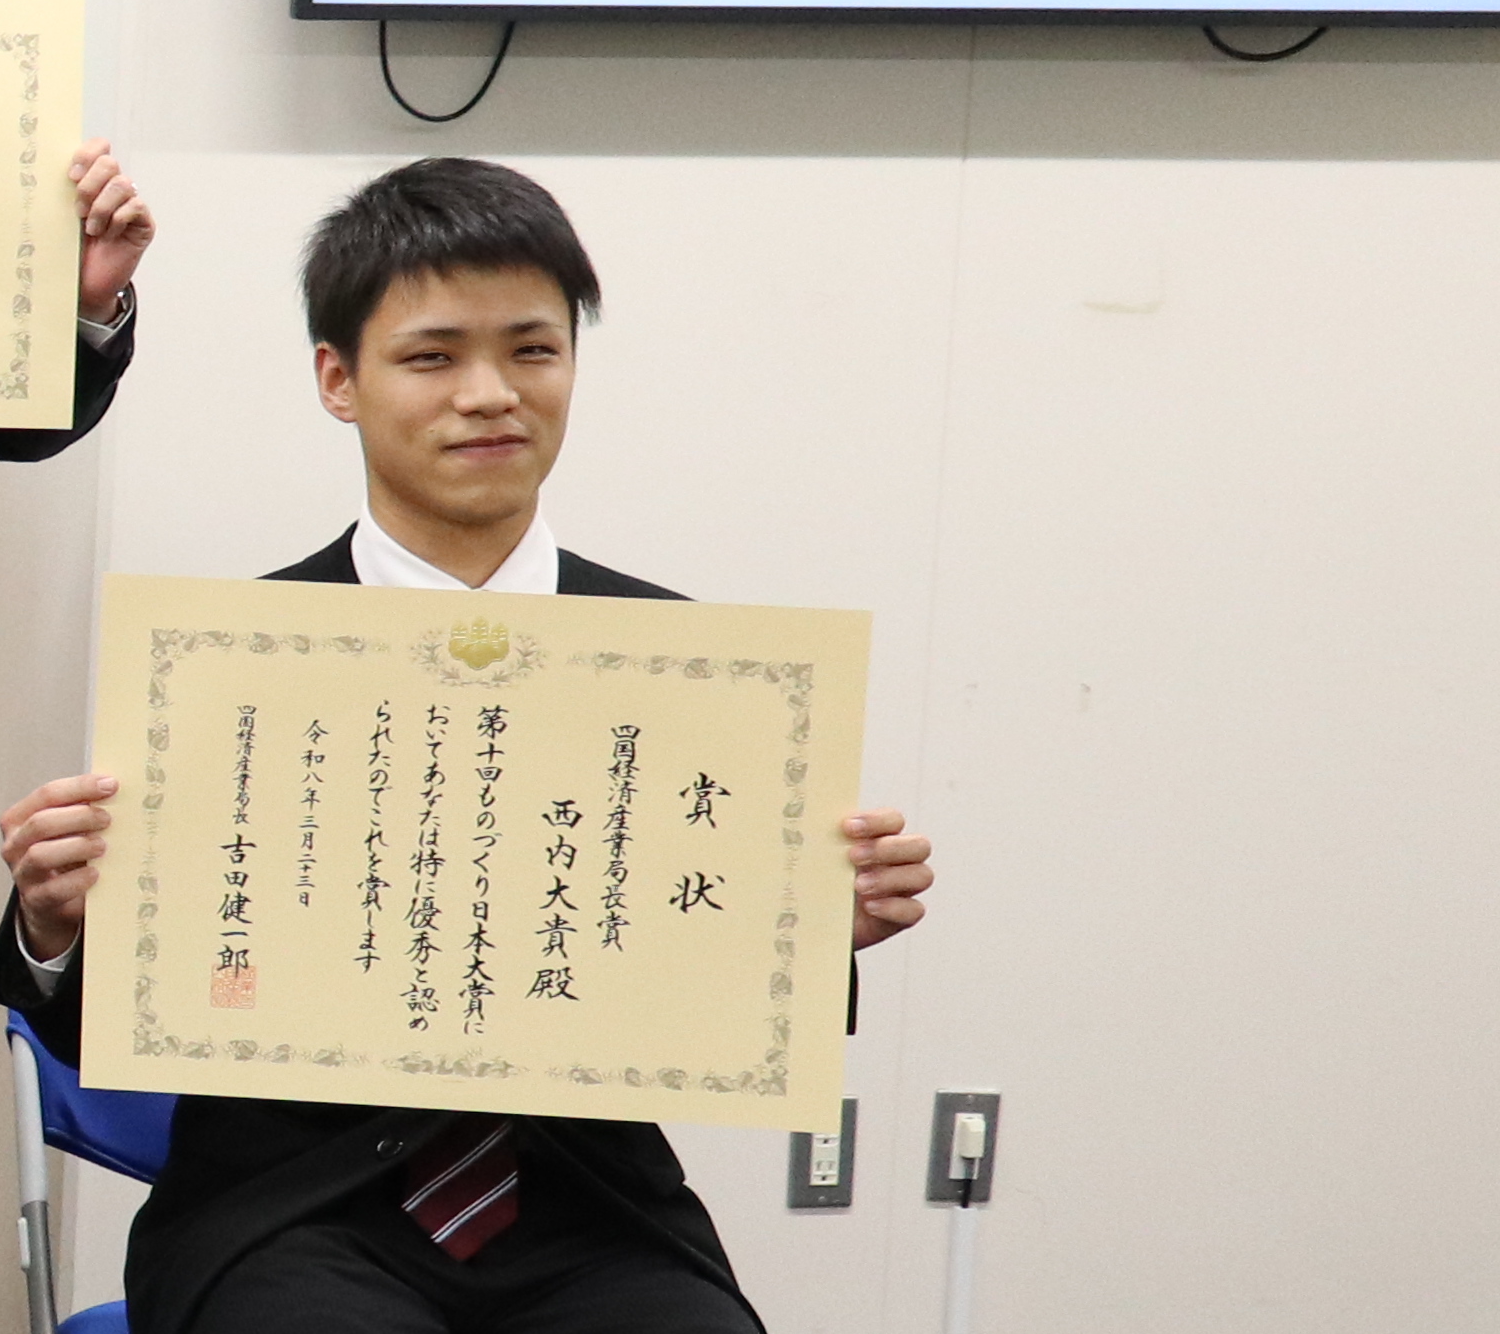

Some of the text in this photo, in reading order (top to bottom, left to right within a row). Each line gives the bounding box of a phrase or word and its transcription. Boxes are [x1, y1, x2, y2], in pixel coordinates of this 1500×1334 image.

[295, 719, 329, 908] 令和八年三月二十三日
[596, 724, 642, 950] 四国経済産業局長賞
